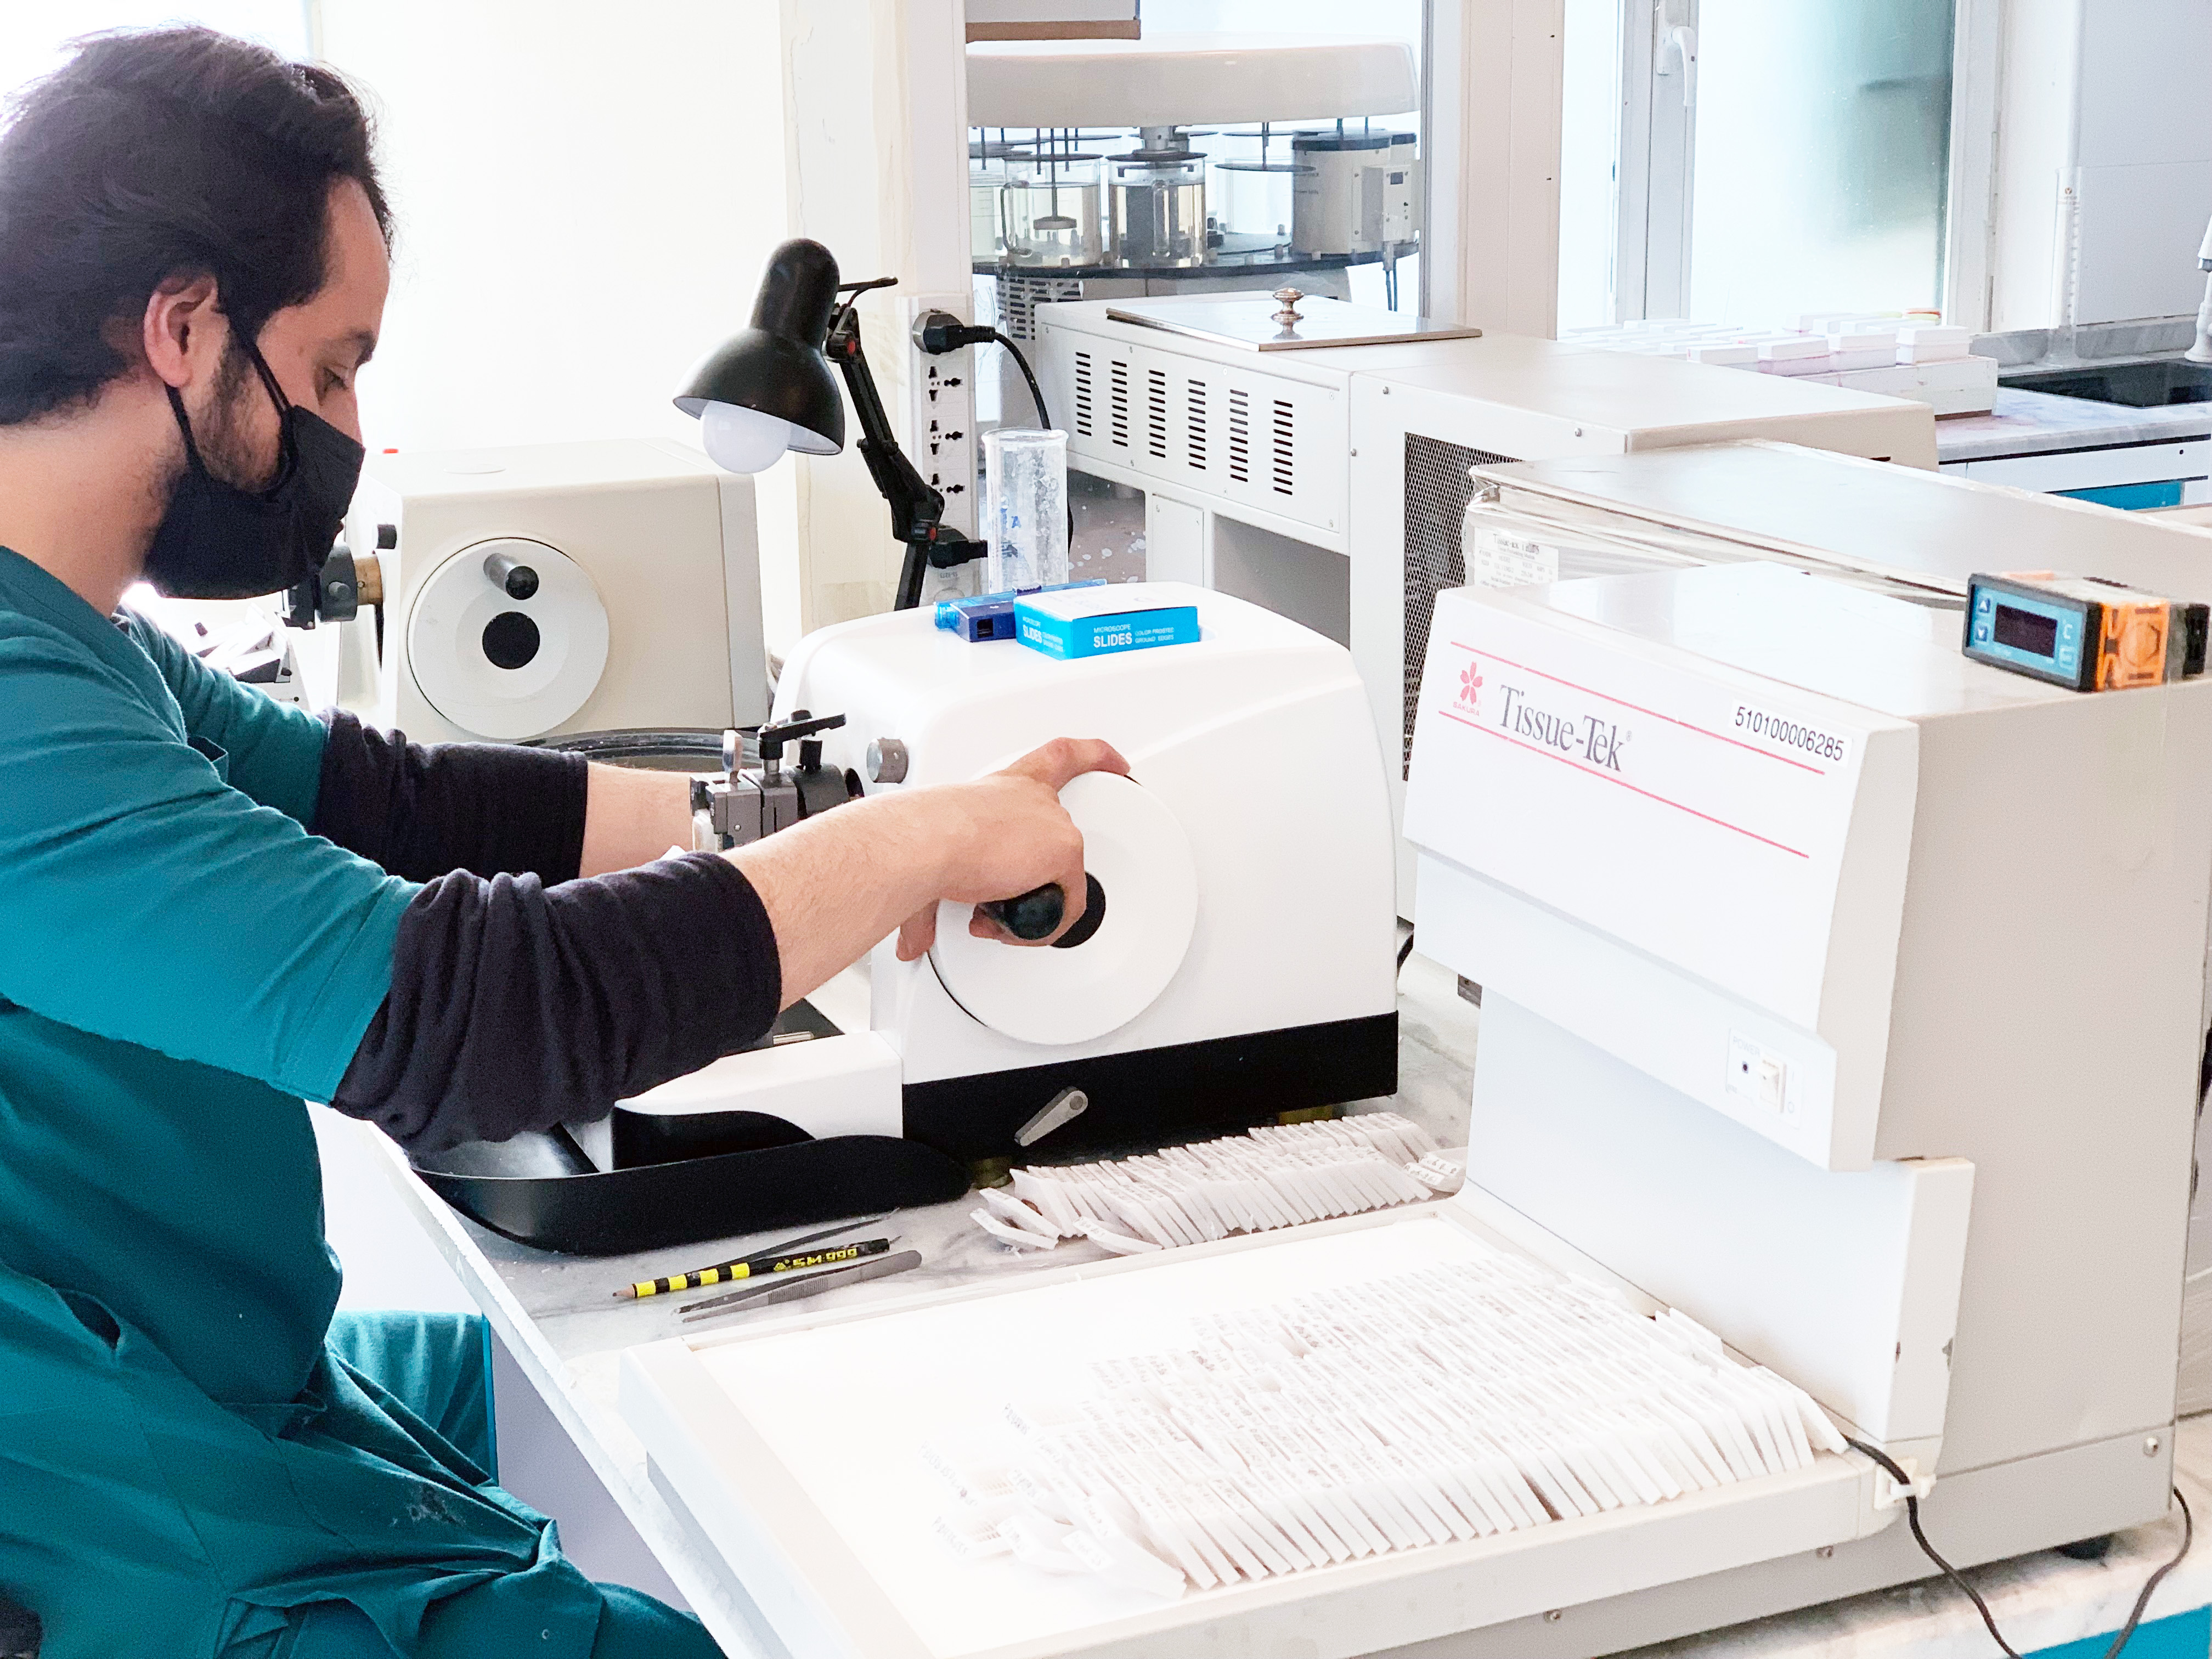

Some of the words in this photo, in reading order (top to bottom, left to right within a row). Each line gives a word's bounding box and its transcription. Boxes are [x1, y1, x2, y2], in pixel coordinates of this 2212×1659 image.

[1023, 624, 1042, 644] SLIDES
[1093, 624, 1131, 633] MICROSCOPE
[1093, 631, 1132, 648] SLIDES
[1453, 701, 1480, 716] SAKURA
[1735, 706, 1844, 761] 510100006285
